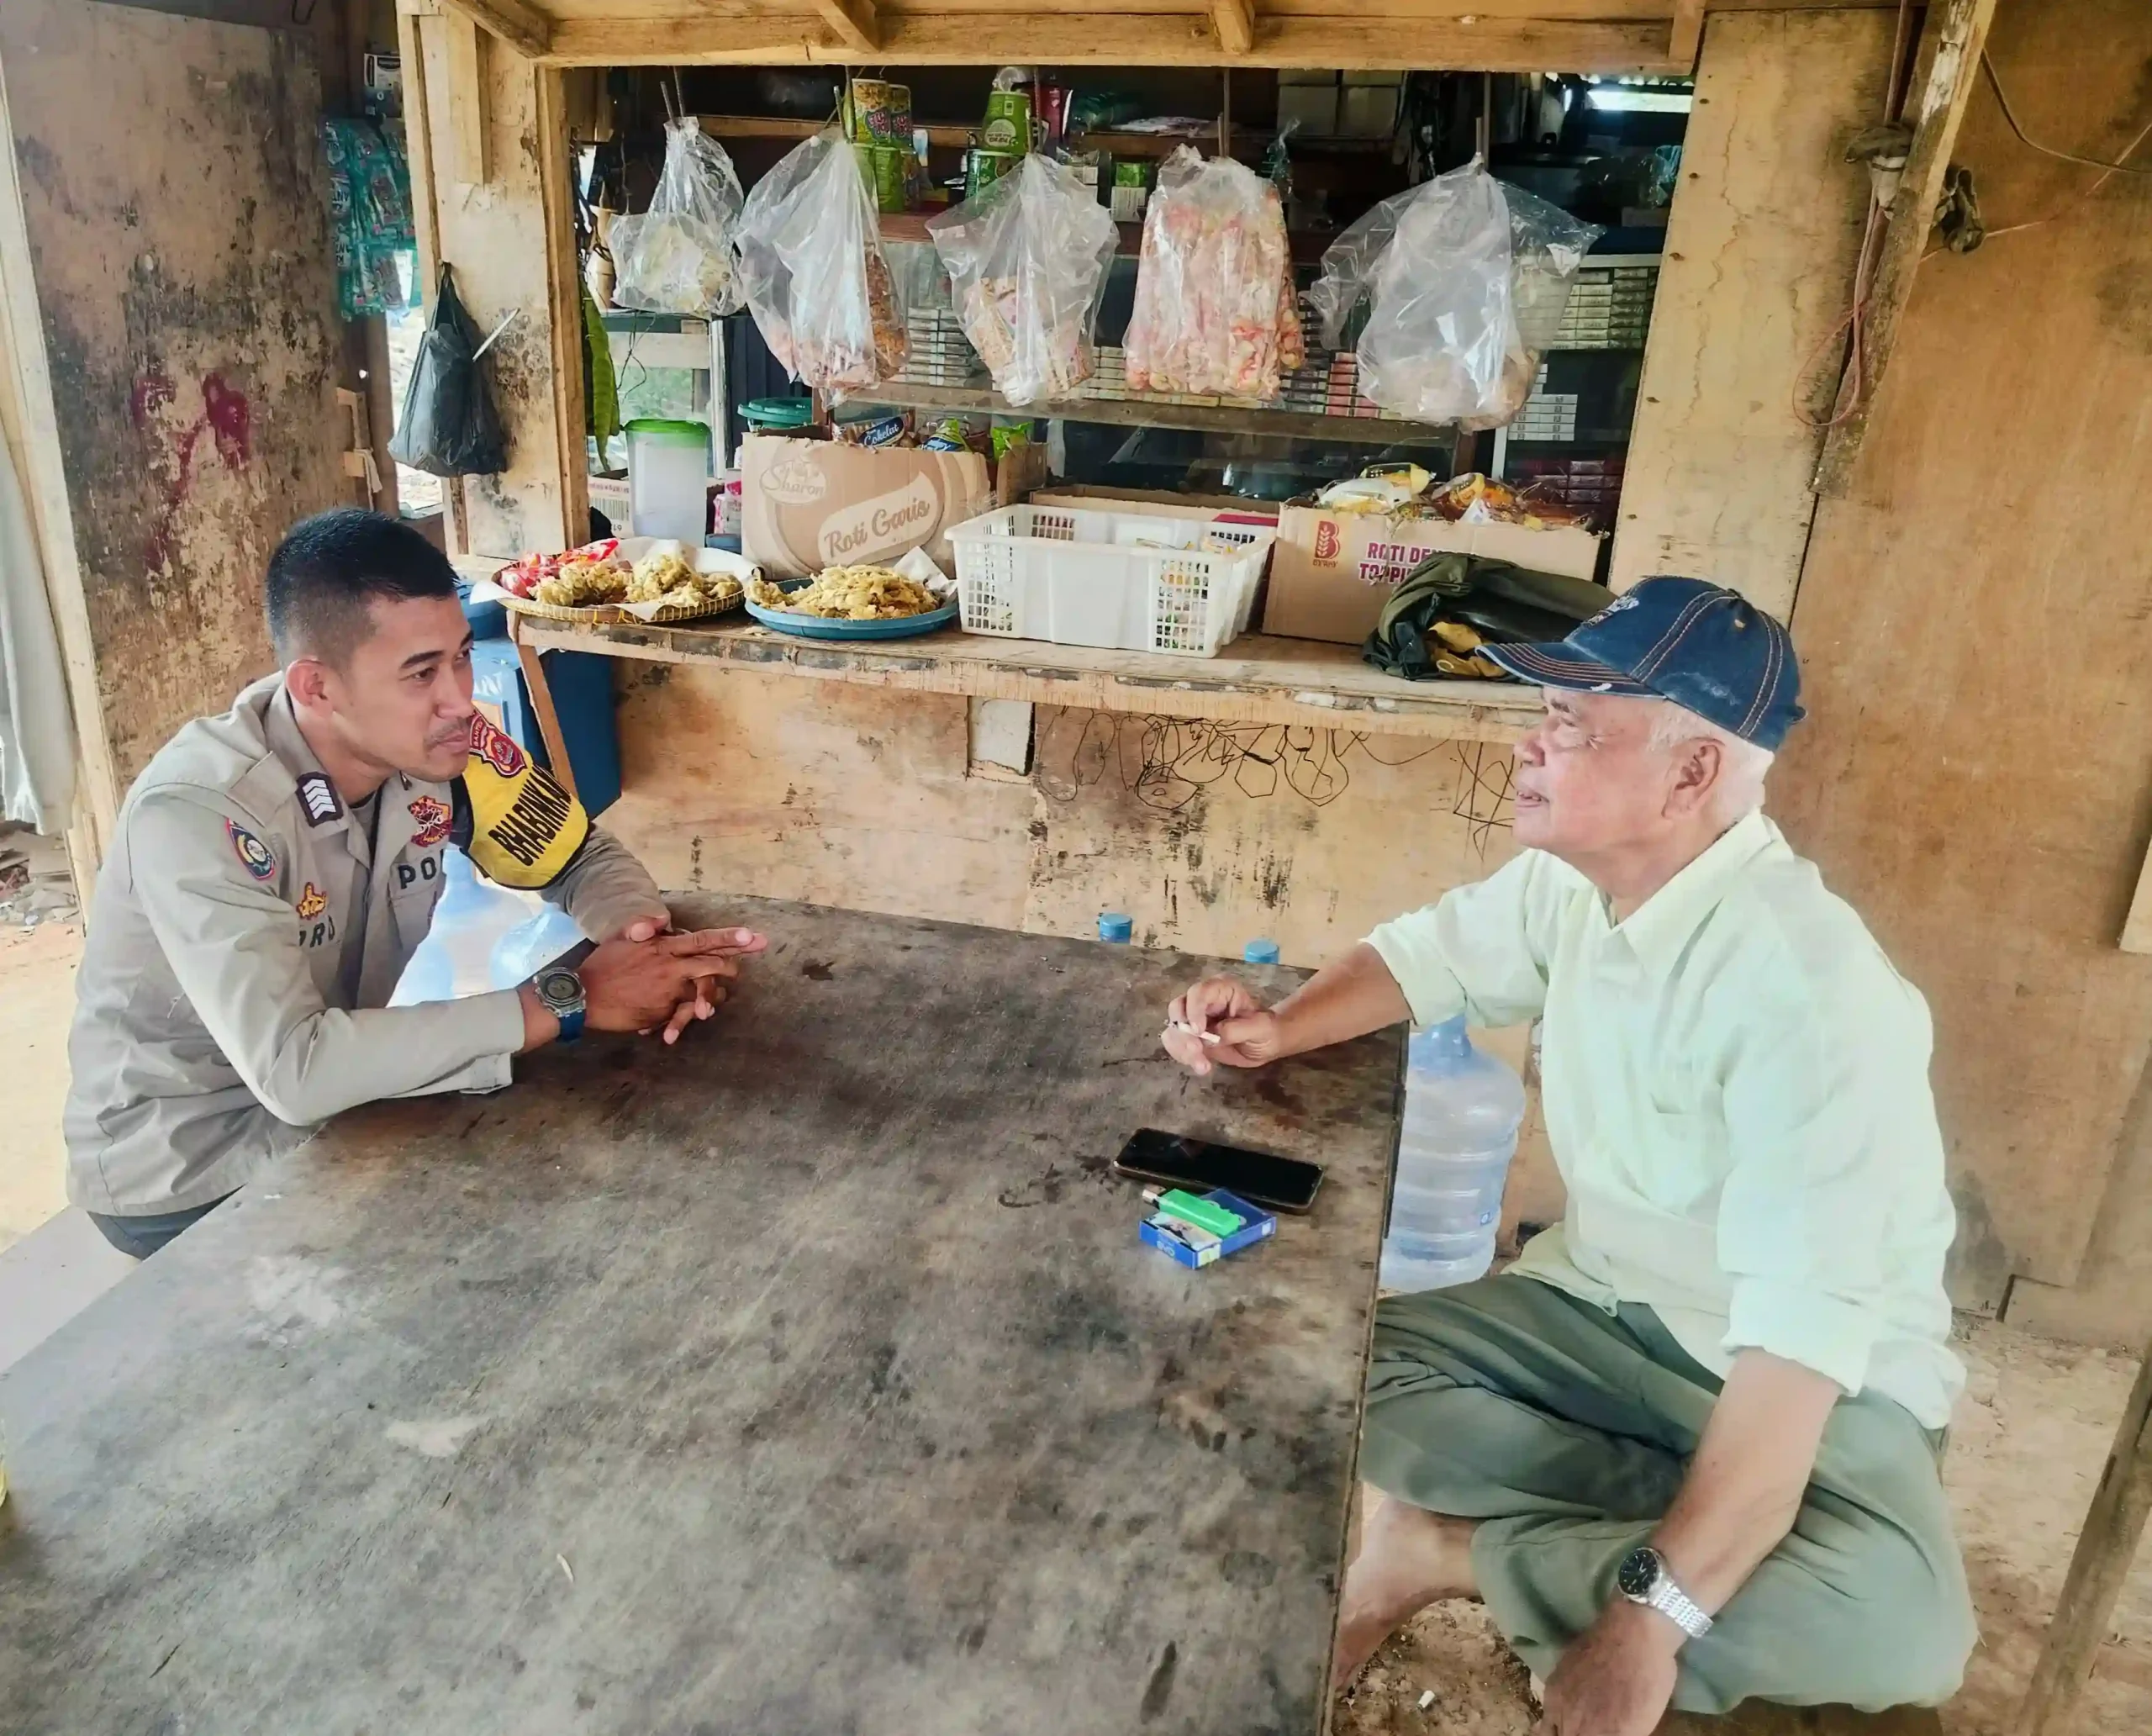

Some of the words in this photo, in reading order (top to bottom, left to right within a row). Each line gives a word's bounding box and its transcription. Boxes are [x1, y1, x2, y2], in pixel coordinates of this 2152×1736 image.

[863, 422, 899, 446] Cokelat
[759, 460, 825, 496] Sharon
[824, 521, 868, 557] Roti
[1368, 542, 1405, 562] ROTI
[1409, 546, 1437, 563] DE
[1359, 562, 1414, 583] TOPPI
[488, 763, 572, 866] BHABINKA
[398, 851, 442, 889] PO
